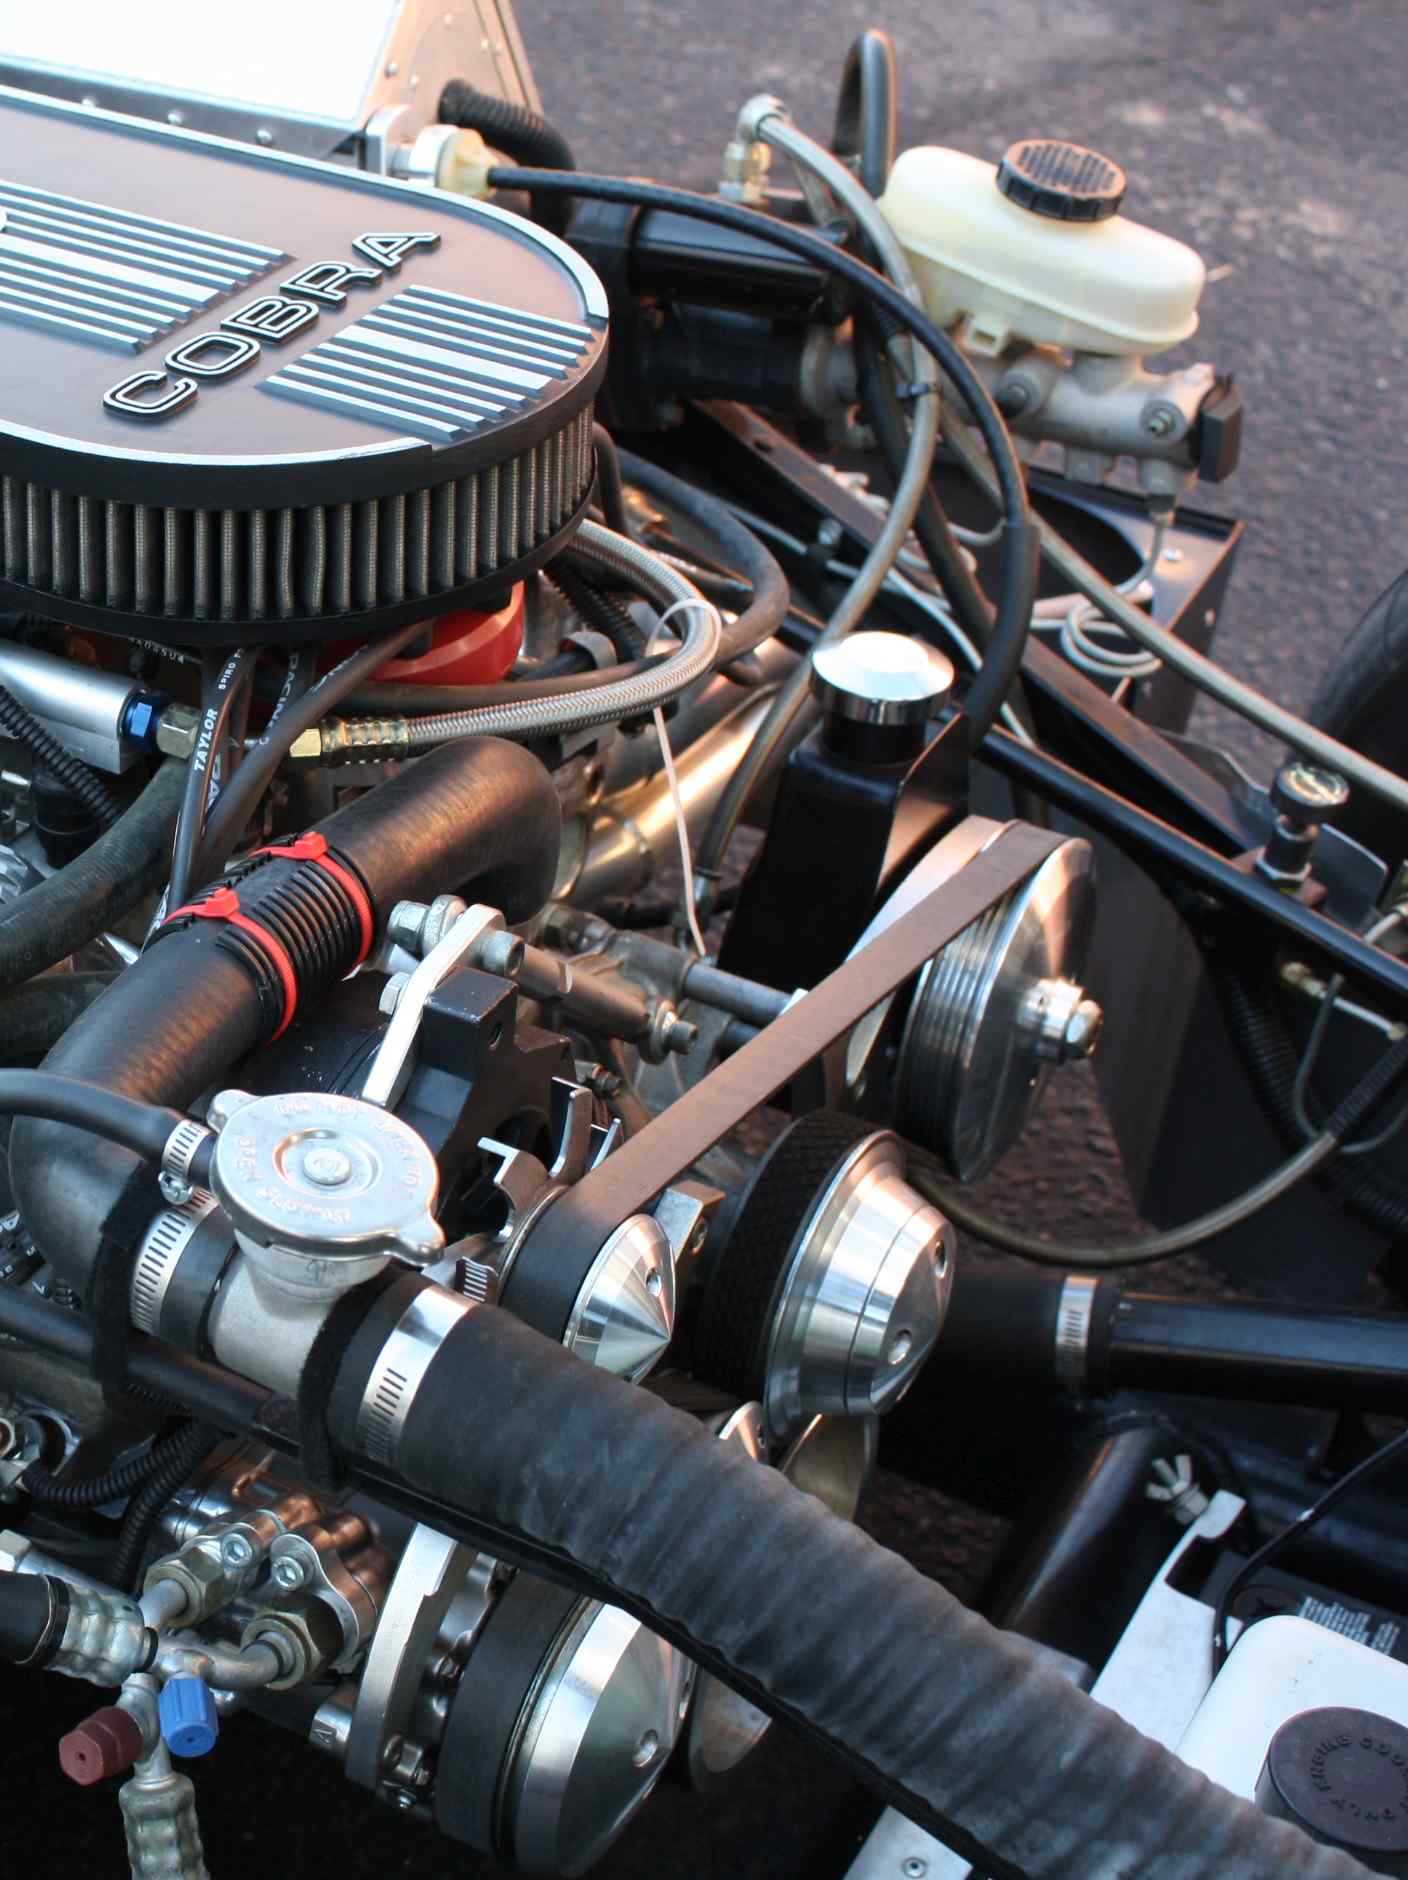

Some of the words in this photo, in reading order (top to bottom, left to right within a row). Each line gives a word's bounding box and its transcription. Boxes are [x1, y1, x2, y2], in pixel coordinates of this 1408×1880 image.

[103, 232, 441, 422] COBRA
[194, 708, 218, 772] TAYLOR
[217, 661, 237, 691] SPIRO
